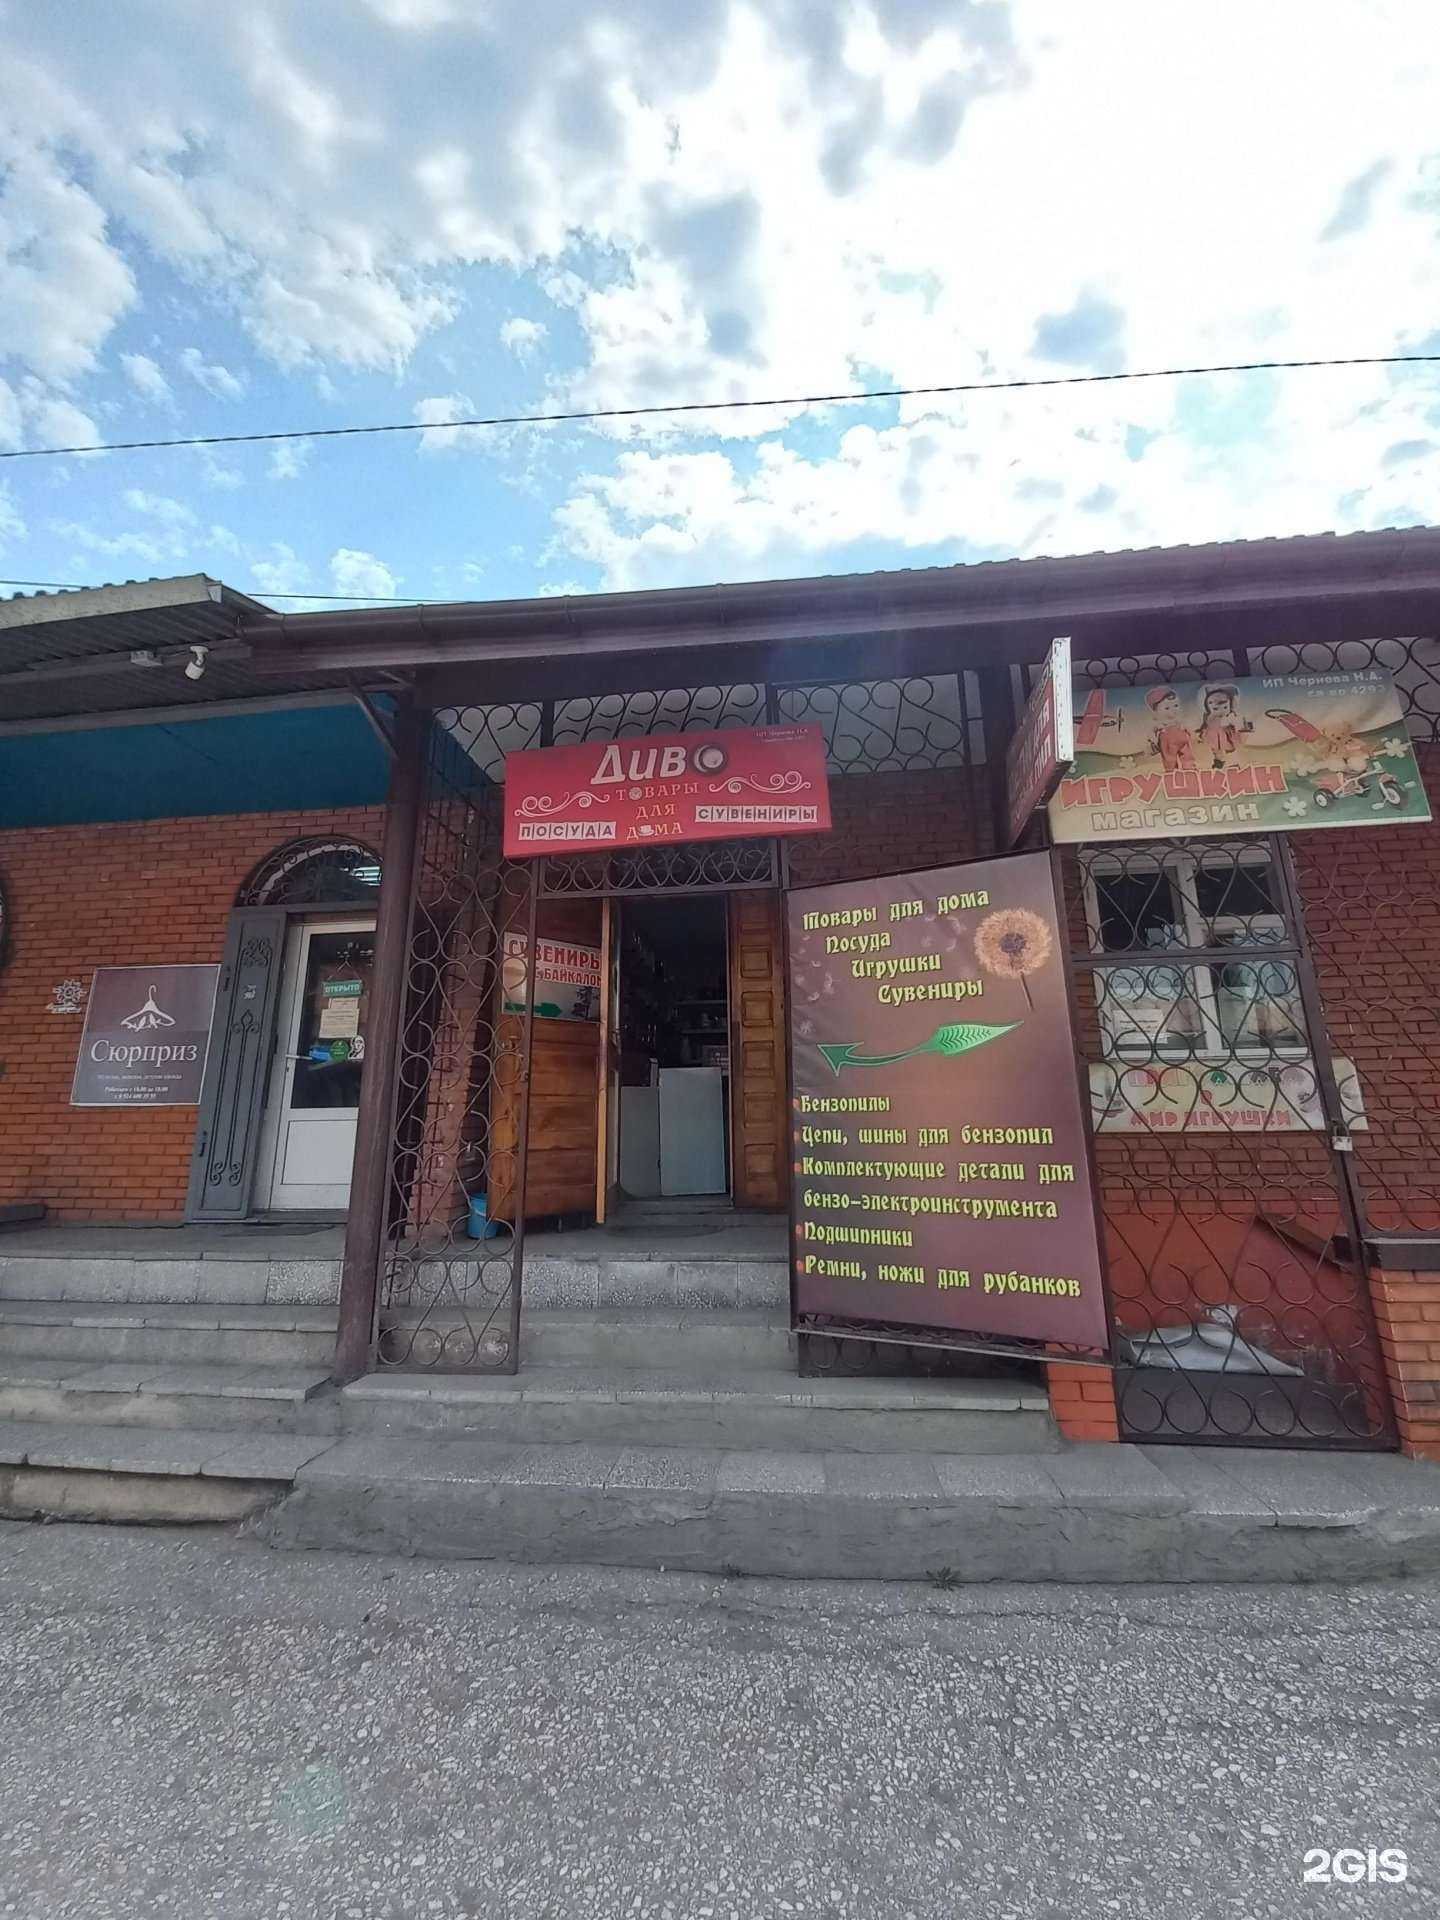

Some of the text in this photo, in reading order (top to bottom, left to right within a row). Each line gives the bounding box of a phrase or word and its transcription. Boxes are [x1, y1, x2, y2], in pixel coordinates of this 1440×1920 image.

[1262, 678, 1284, 689] ИП
[1288, 674, 1350, 688] Чернова
[1060, 766, 1288, 809] ИГРУШКИН
[635, 804, 676, 820] ДЛЯ
[697, 806, 817, 822] СУВЕНИРЫ
[1092, 803, 1260, 831] магазин
[520, 823, 614, 839] ПОСУДА
[802, 888, 990, 930] Товары для дома
[825, 932, 891, 955] Посуда
[851, 954, 942, 979] Игрушки
[325, 984, 361, 994] ОТКРЫТО
[878, 979, 983, 1006] Сувениры
[91, 1040, 198, 1068] Сюрприз
[801, 1095, 890, 1113] Бензопилы
[1131, 1110, 1292, 1127] МИР ИГРУШКИ
[802, 1125, 1053, 1147] Цепи, шины для бензопил
[802, 1157, 1074, 1184] Комплектующие детали для
[804, 1222, 913, 1247] Подшипники
[805, 1255, 1081, 1297] Ремни, ножи для рубанков
